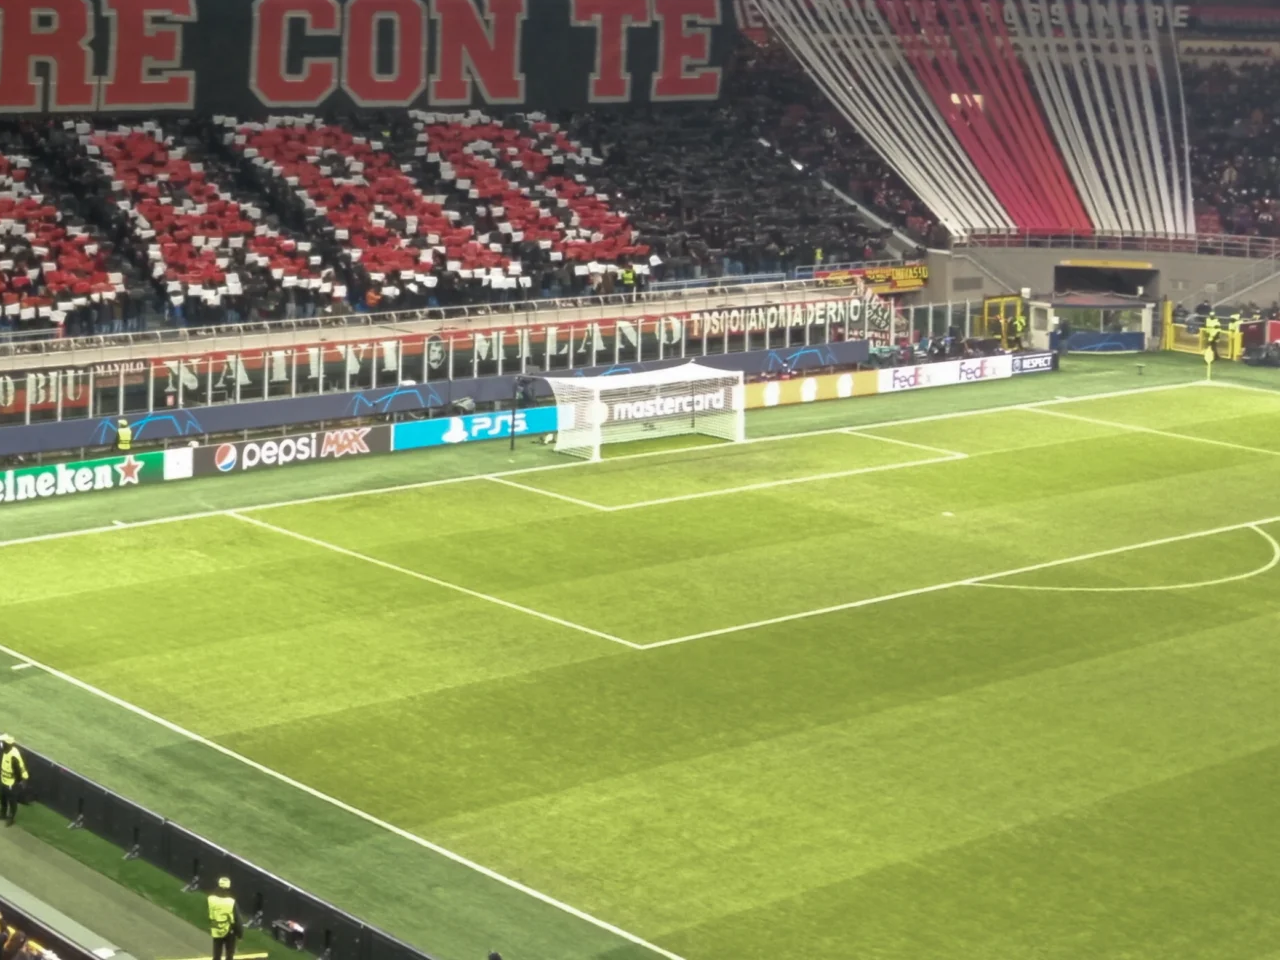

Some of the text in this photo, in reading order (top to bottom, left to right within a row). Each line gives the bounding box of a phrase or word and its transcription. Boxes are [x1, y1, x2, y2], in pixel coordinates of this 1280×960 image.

[470, 316, 682, 363] MILANO
[1022, 356, 1052, 369] RESPECT
[613, 388, 725, 421] mastercard
[471, 414, 530, 437] PS5
[242, 426, 373, 470] pepsi MAX
